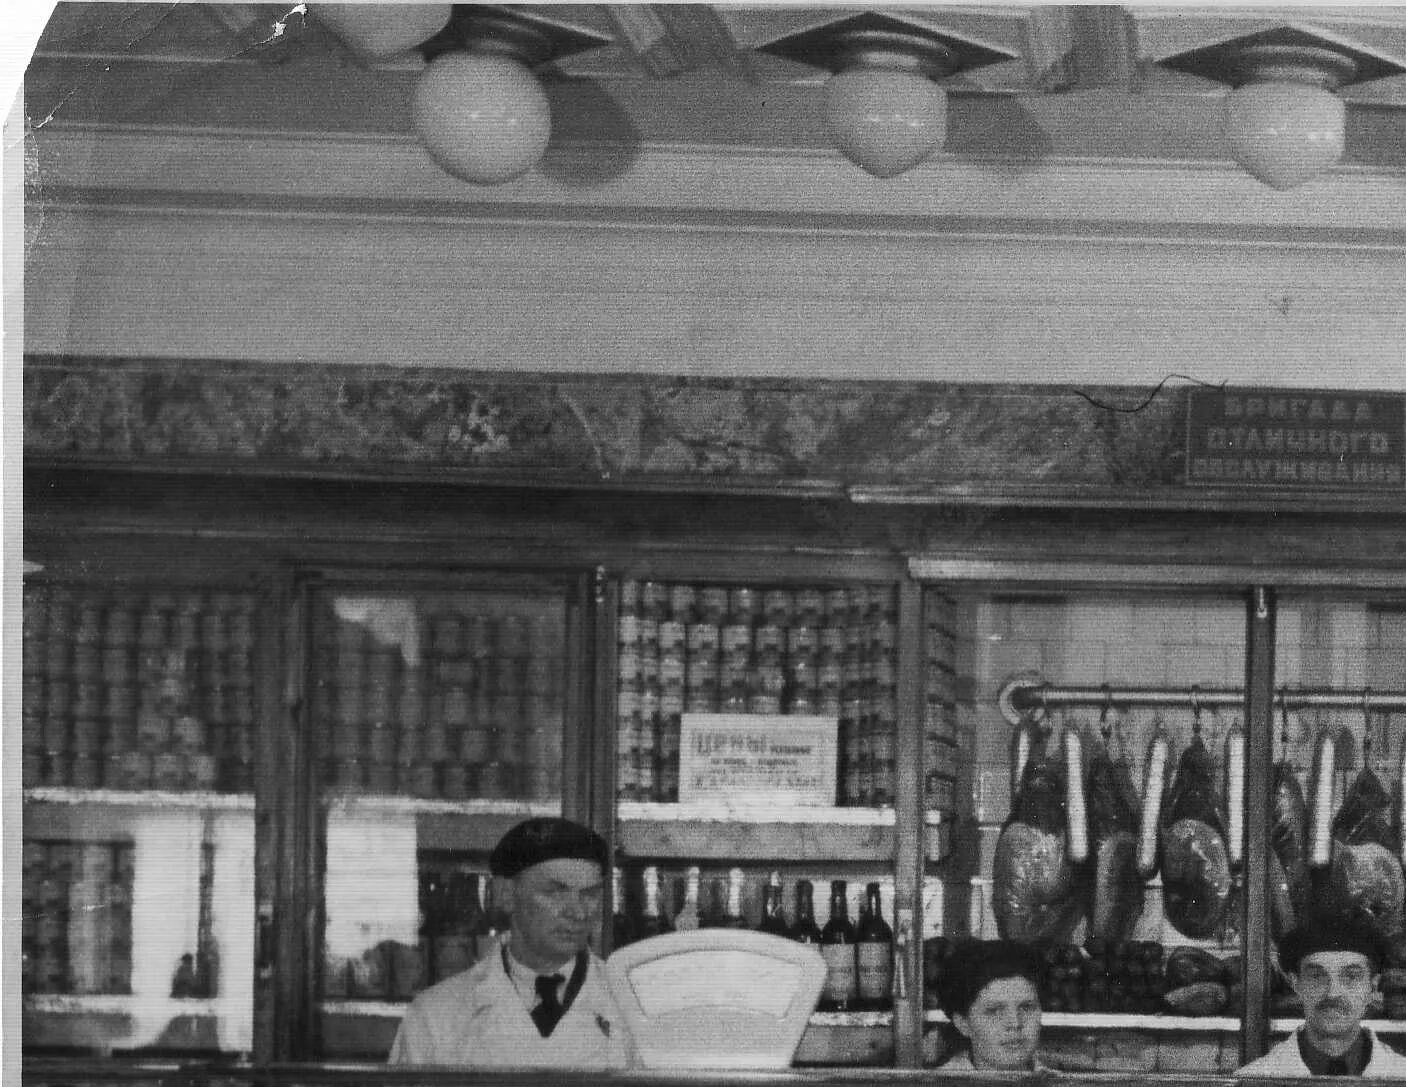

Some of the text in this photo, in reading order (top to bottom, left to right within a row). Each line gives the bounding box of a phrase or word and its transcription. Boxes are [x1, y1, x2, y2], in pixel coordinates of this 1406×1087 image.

[1224, 397, 1372, 422] БРИГАДА
[1206, 426, 1389, 454] ОТЛИЧНОГО
[1192, 457, 1401, 484] ОБСЛУЖИВАНИЯ
